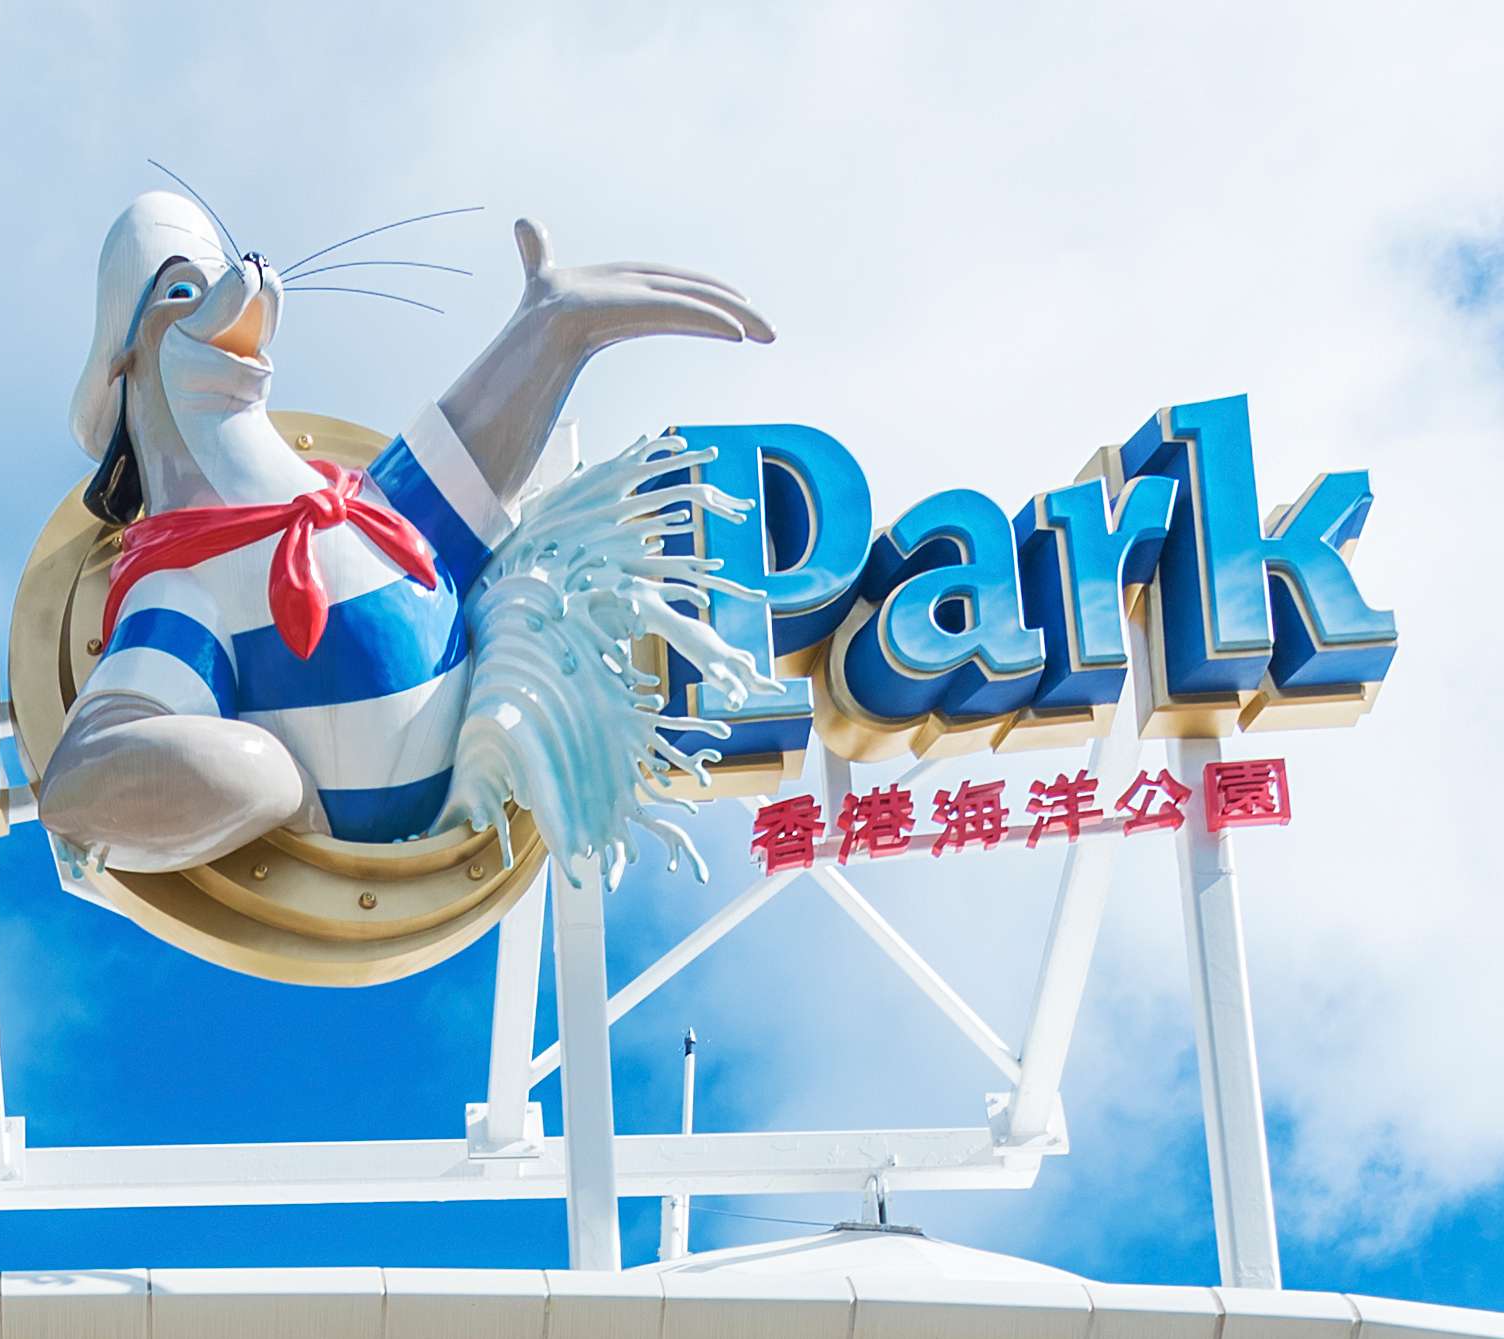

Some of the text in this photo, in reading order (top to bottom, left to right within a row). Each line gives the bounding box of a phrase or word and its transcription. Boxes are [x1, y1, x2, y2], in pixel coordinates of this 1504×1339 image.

[647, 393, 1398, 775] Park
[751, 759, 1292, 876] 香港海洋公園
